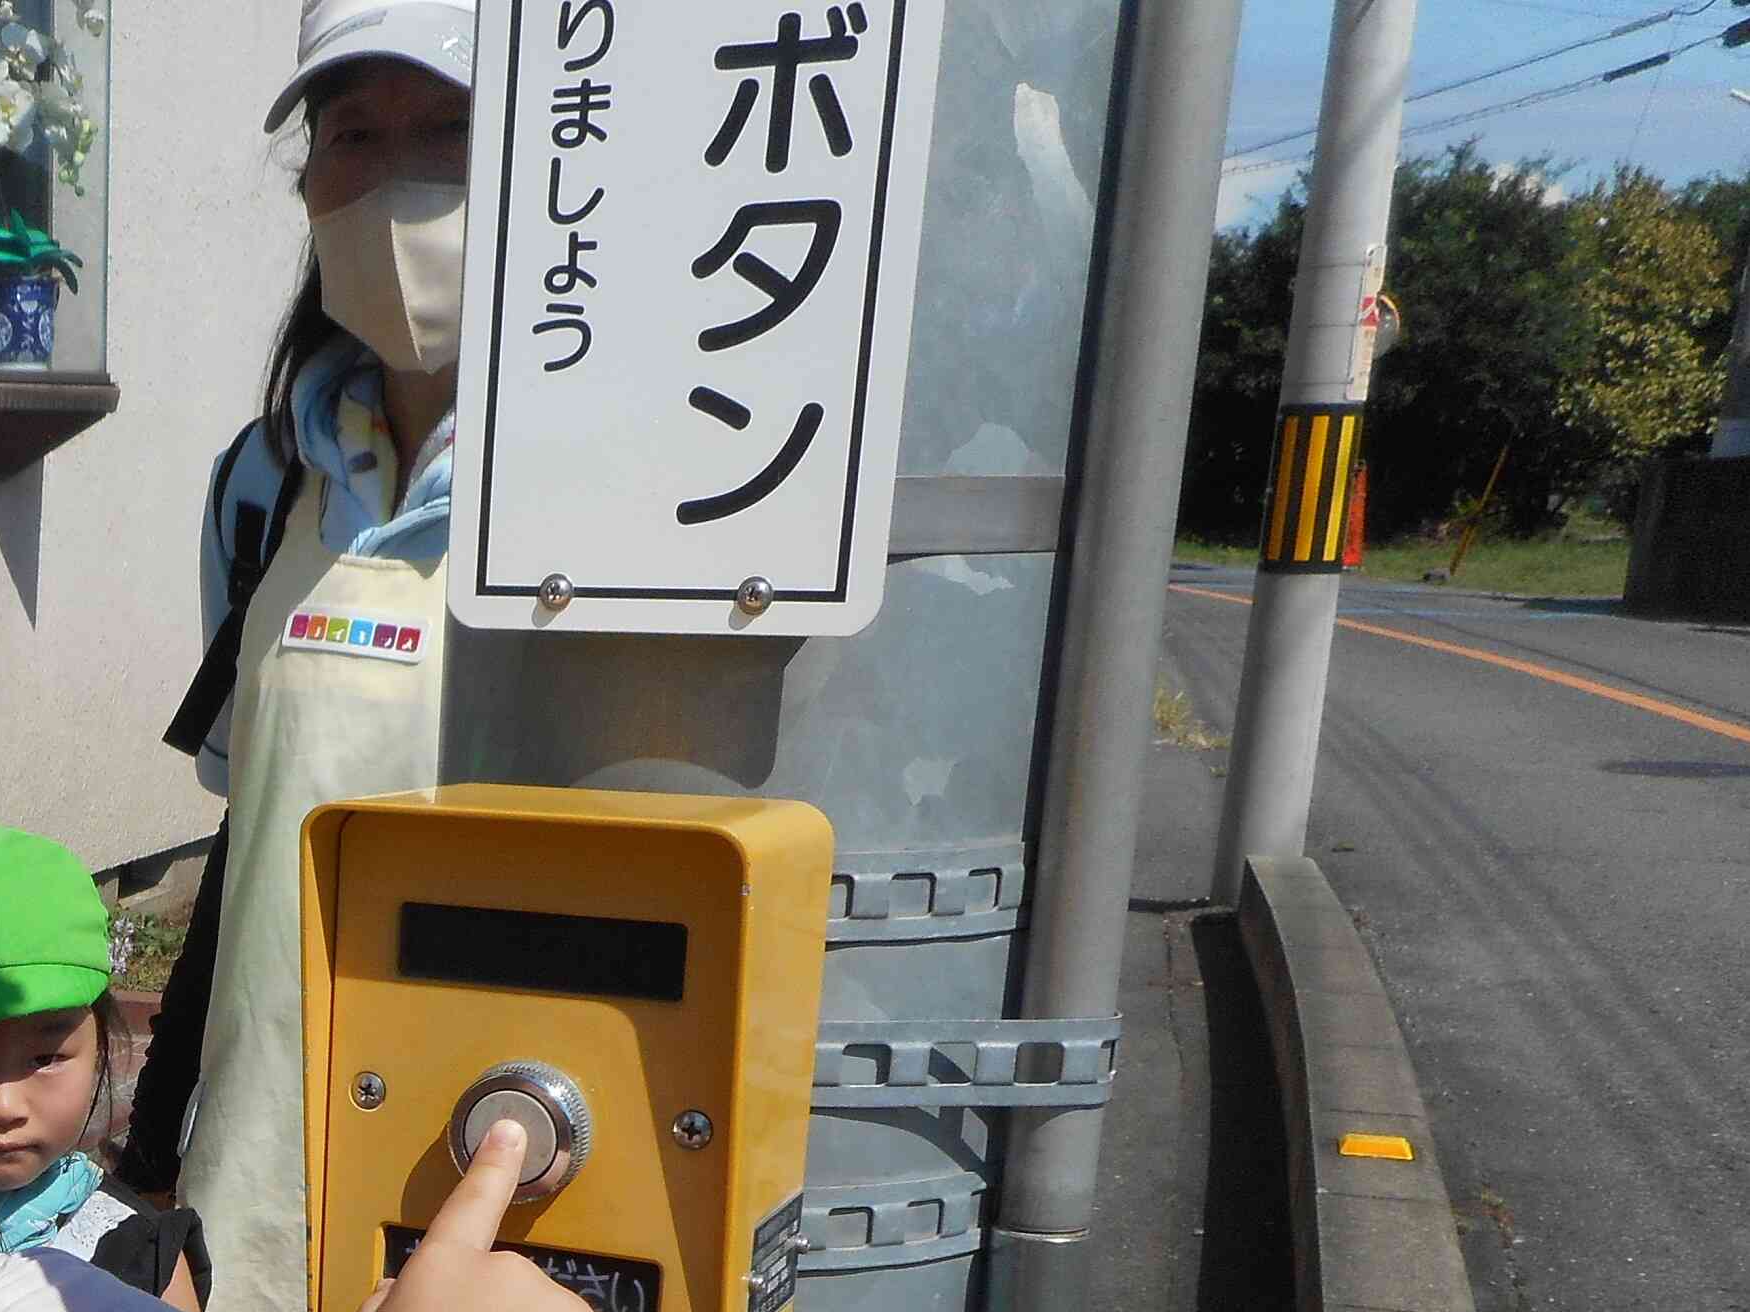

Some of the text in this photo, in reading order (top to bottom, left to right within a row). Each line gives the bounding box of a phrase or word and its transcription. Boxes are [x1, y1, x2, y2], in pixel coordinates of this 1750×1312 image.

[532, 0, 615, 372] りましょう
[676, 2, 869, 526] ボタン
